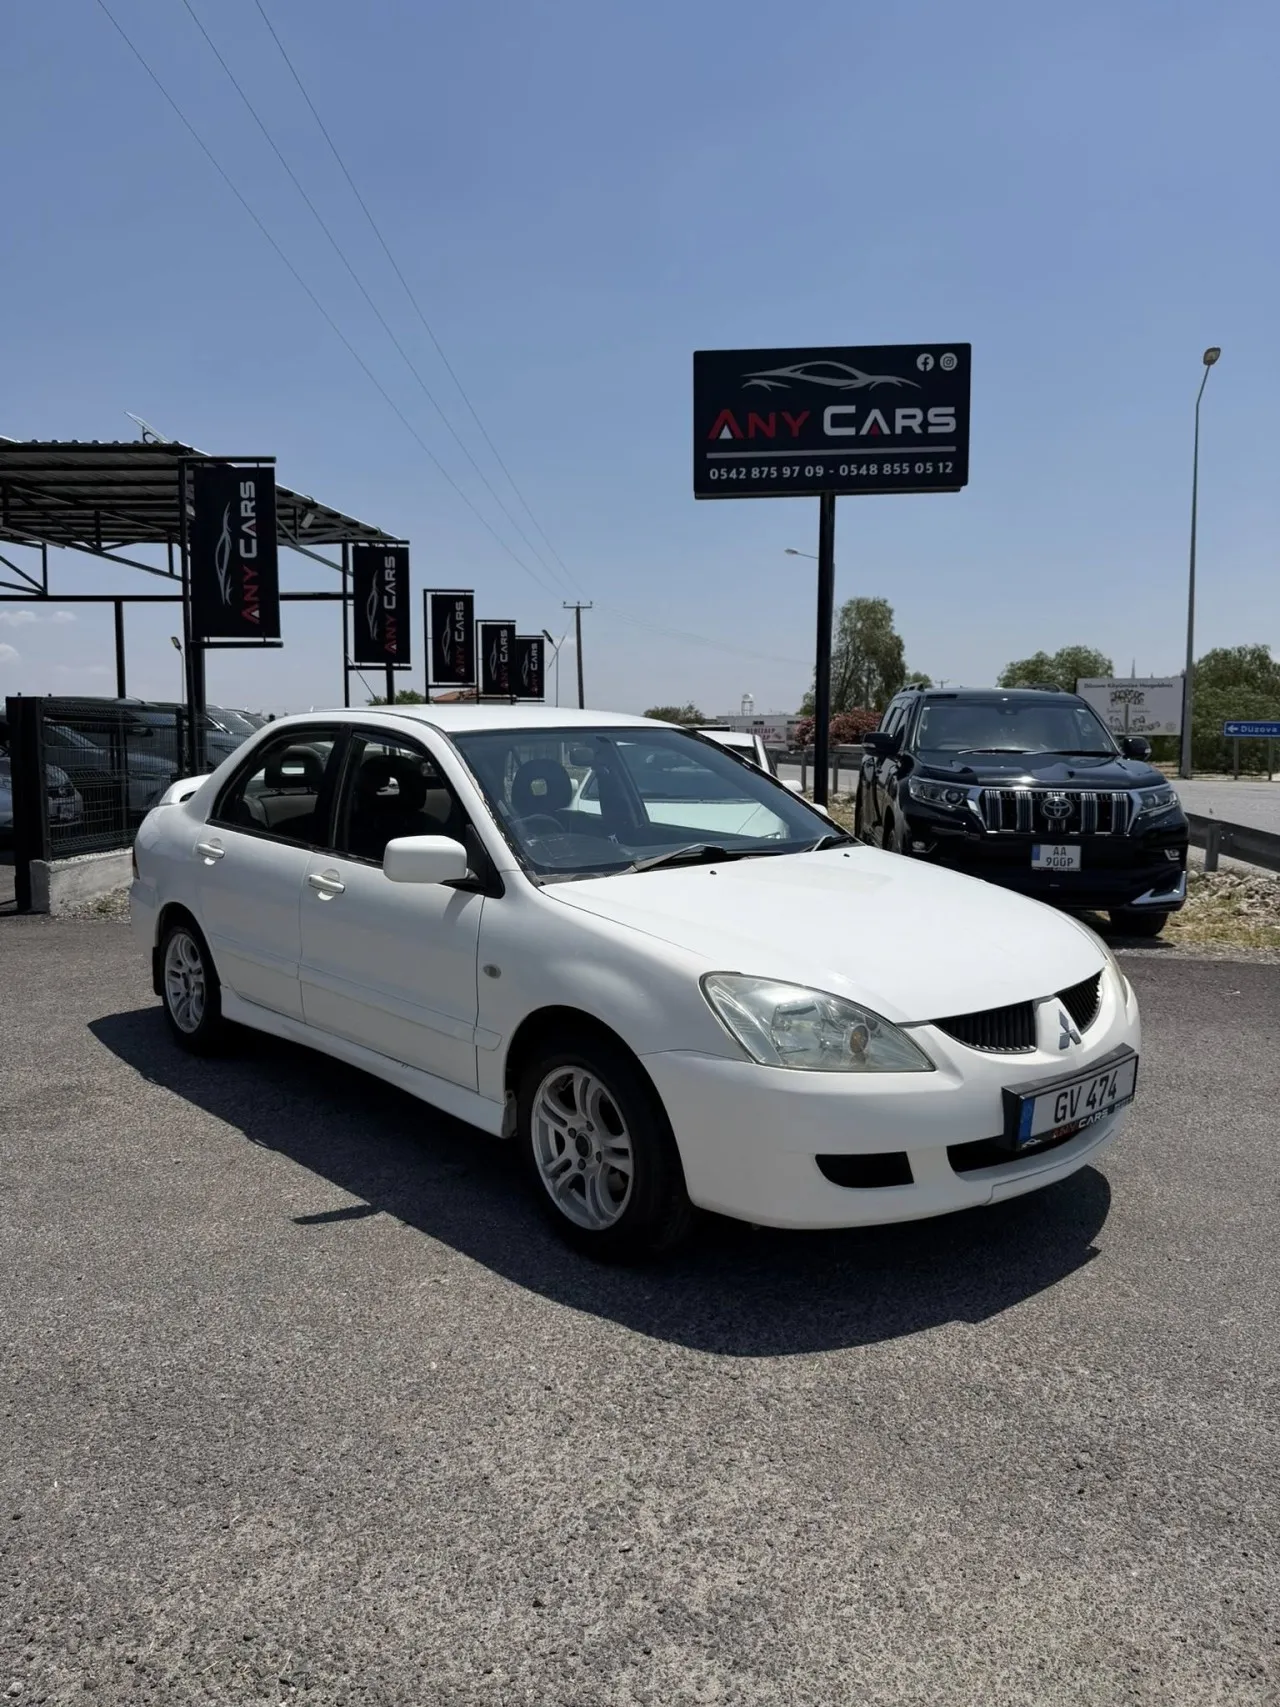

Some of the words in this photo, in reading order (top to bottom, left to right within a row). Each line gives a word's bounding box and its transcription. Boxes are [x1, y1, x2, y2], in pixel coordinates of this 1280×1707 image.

[707, 408, 811, 440] ANY
[822, 404, 957, 437] CARS
[709, 466, 747, 479] 0542
[751, 466, 778, 479] 875
[782, 466, 800, 478] 97
[804, 465, 824, 477] 09
[839, 464, 878, 476] 0548
[882, 463, 910, 475] 855
[914, 462, 933, 474] 05
[938, 461, 953, 473] 12
[239, 480, 258, 559] CARS
[241, 564, 260, 625] ANY
[383, 555, 396, 610] CARS
[384, 614, 397, 655] ANY
[454, 601, 464, 642] CARS
[455, 645, 465, 677] ANY
[499, 629, 508, 662] CARS
[530, 642, 538, 671] CARS
[1053, 846, 1067, 856] AA
[1054, 1086, 1082, 1124] GV
[1086, 1070, 1118, 1110] 474
[1078, 1108, 1109, 1129] CARS
